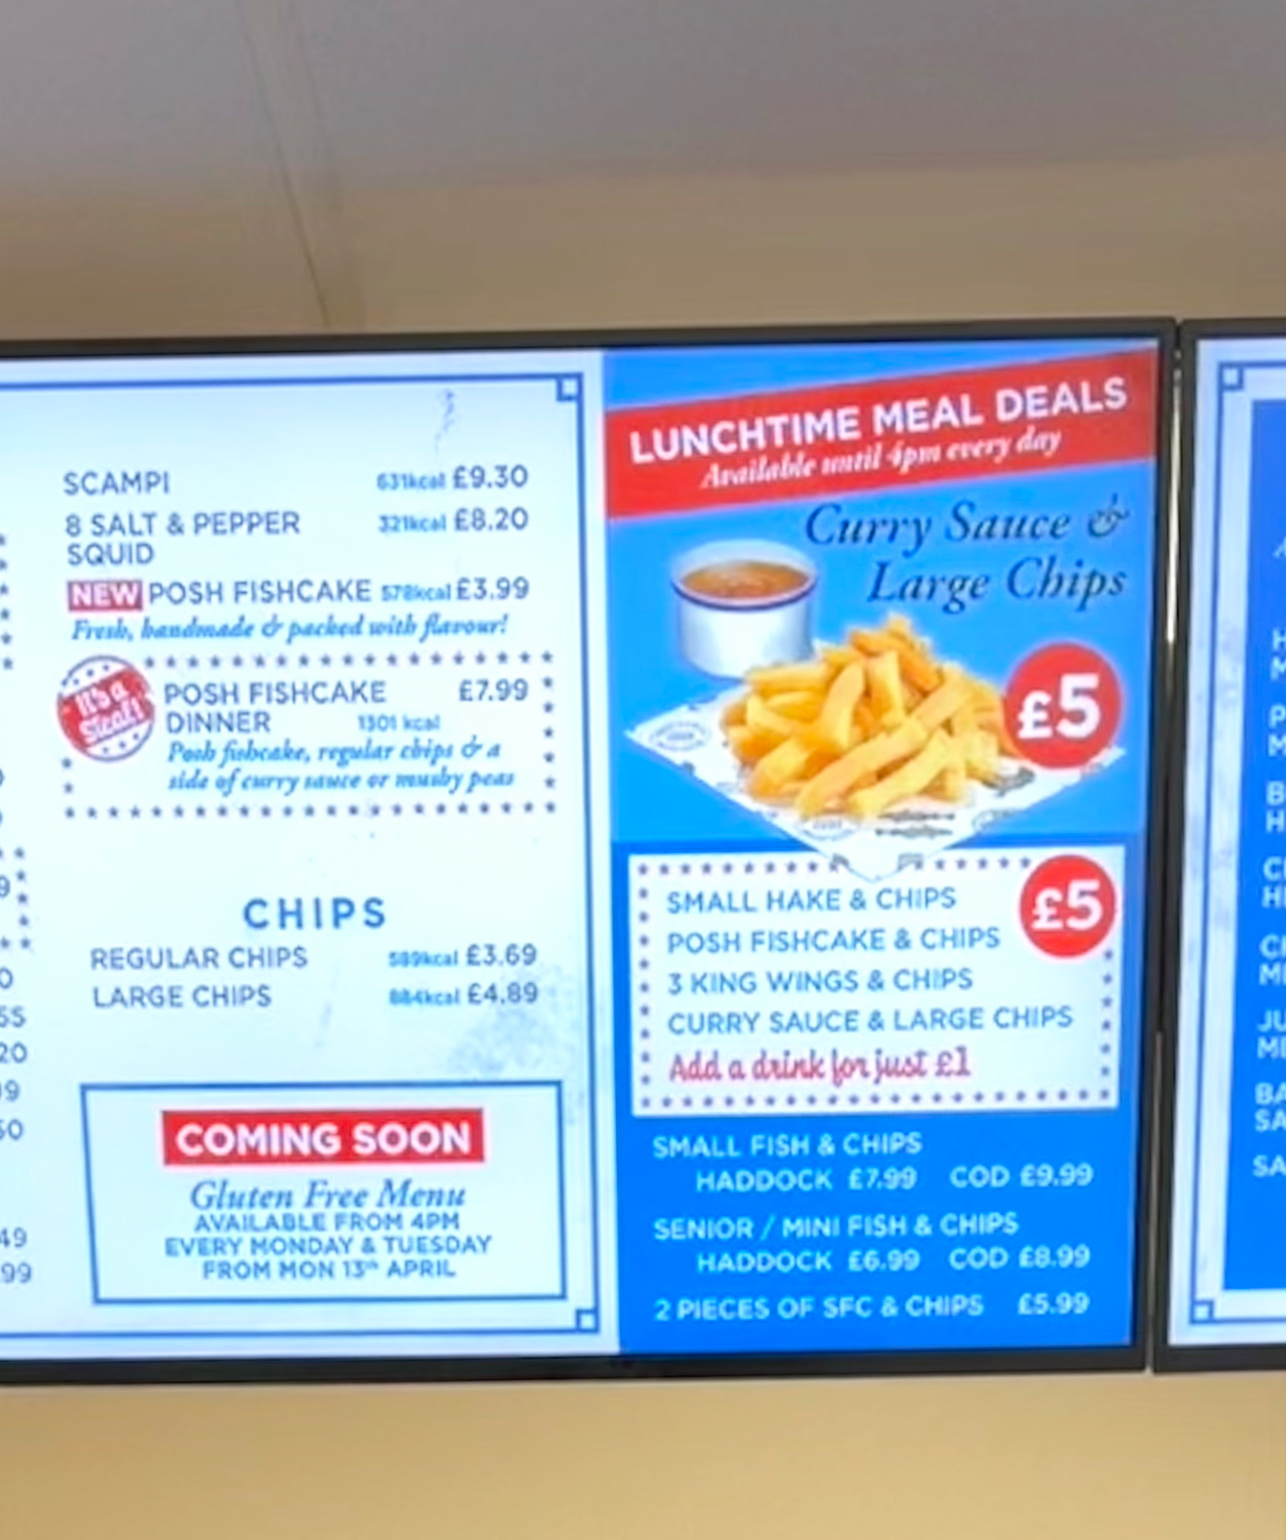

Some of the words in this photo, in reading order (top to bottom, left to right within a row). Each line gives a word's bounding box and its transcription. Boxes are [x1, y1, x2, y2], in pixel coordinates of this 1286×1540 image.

[630, 408, 860, 464] LUNCHTIME
[873, 394, 984, 435] MEAL
[996, 377, 1128, 420] DEALS
[702, 452, 816, 487] Available
[822, 443, 882, 474] until
[887, 441, 941, 474] 4pm
[946, 438, 1011, 463] every
[1016, 425, 1061, 456] day
[64, 471, 169, 496] SCAMPI
[453, 464, 528, 489] £9.30
[65, 513, 82, 538] 8
[91, 512, 157, 537] SALT
[166, 512, 184, 536] &
[193, 511, 300, 535] PEPPER
[454, 507, 529, 531] £8.20
[805, 503, 932, 558] Curry
[945, 501, 1070, 541] Sauce
[1087, 493, 1130, 538] &
[68, 542, 154, 566] SQUID
[70, 584, 141, 606] NEW
[149, 581, 223, 605] POSH
[234, 579, 371, 604] FISHCAKE
[456, 576, 529, 600] £3.99
[868, 561, 990, 618] Large
[1007, 555, 1127, 612] Chips
[164, 683, 239, 706] POSH
[249, 681, 386, 705] FISHCAKE
[459, 678, 528, 702] £7.99
[1018, 674, 1100, 739] £5
[166, 710, 270, 734] DINNER
[403, 715, 440, 731] kcal
[243, 897, 385, 930] CHIPS
[667, 891, 757, 914] SMALL
[767, 889, 841, 911] HAKE
[849, 889, 866, 911] &
[876, 886, 957, 910] CHIPS
[1032, 880, 1102, 930] £5
[91, 947, 219, 970] REGULAR
[228, 945, 308, 969] CHIPS
[466, 943, 537, 966] £3.69
[93, 985, 183, 1008] LARGE
[192, 984, 272, 1008] CHIPS
[467, 981, 539, 1005] £4.89
[669, 1050, 723, 1082] Add
[728, 1060, 746, 1080] a
[752, 1049, 825, 1081] drink
[831, 1048, 871, 1088] for
[873, 1048, 928, 1085] just
[935, 1045, 971, 1077] £1
[176, 1123, 341, 1156] COMING
[354, 1123, 470, 1155] SOON
[696, 1168, 833, 1192] HADDOCK
[848, 1165, 917, 1190] £7.99
[950, 1165, 1010, 1188] COD
[1020, 1162, 1093, 1187] £9.99
[190, 1179, 293, 1210] Gluten
[304, 1180, 368, 1208] Free
[376, 1178, 465, 1208] Menu
[195, 1213, 326, 1232] AVAILABLE
[334, 1212, 403, 1231] FROM
[411, 1212, 459, 1230] 4PM
